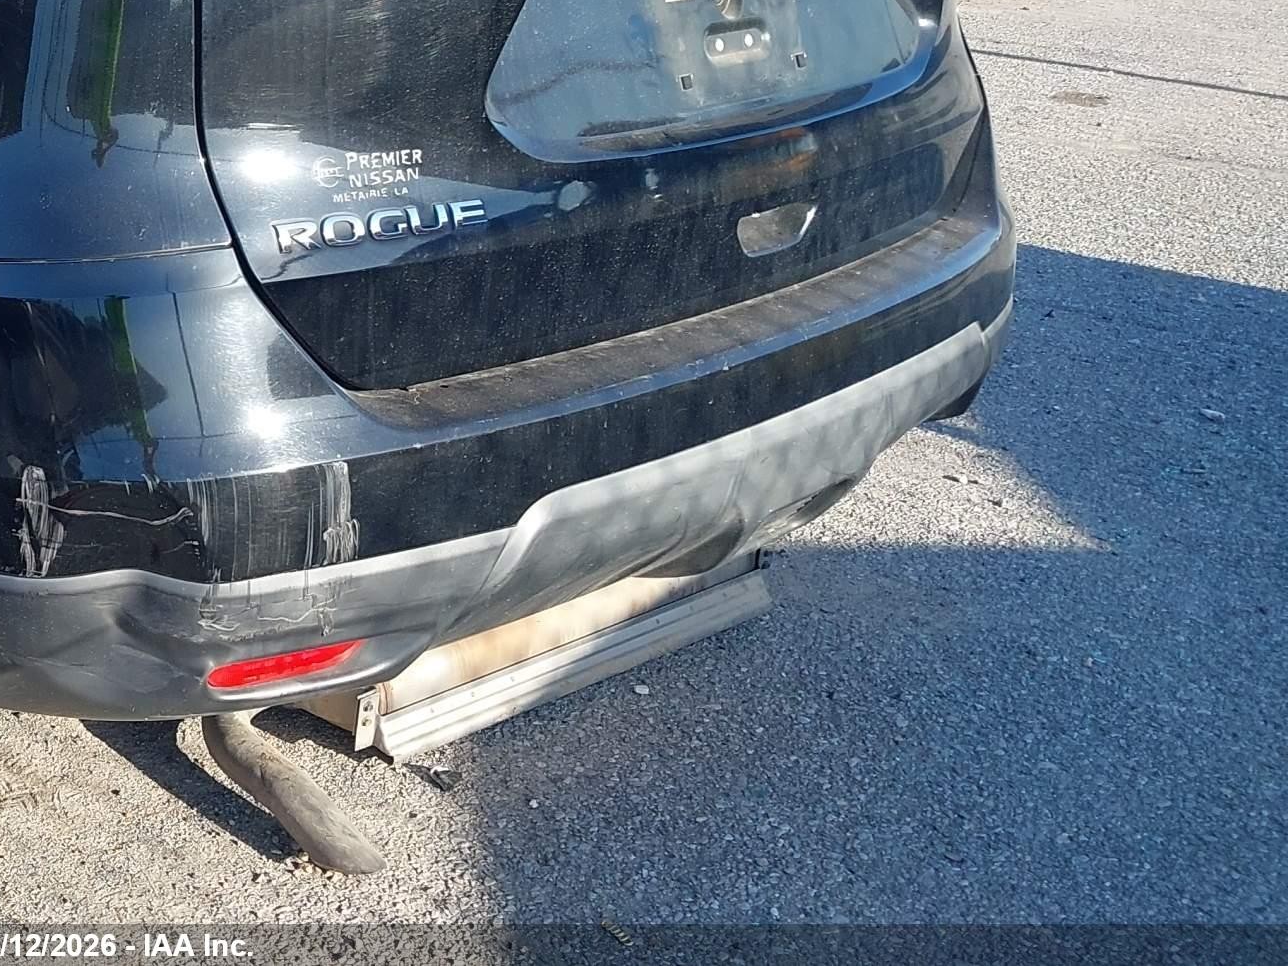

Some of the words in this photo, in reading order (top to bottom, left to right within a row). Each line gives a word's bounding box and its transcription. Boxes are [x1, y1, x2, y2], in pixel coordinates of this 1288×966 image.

[345, 149, 423, 171] PREMIER
[349, 167, 420, 188] NISSAN
[394, 187, 409, 196] LA
[271, 198, 489, 254] ROGUE
